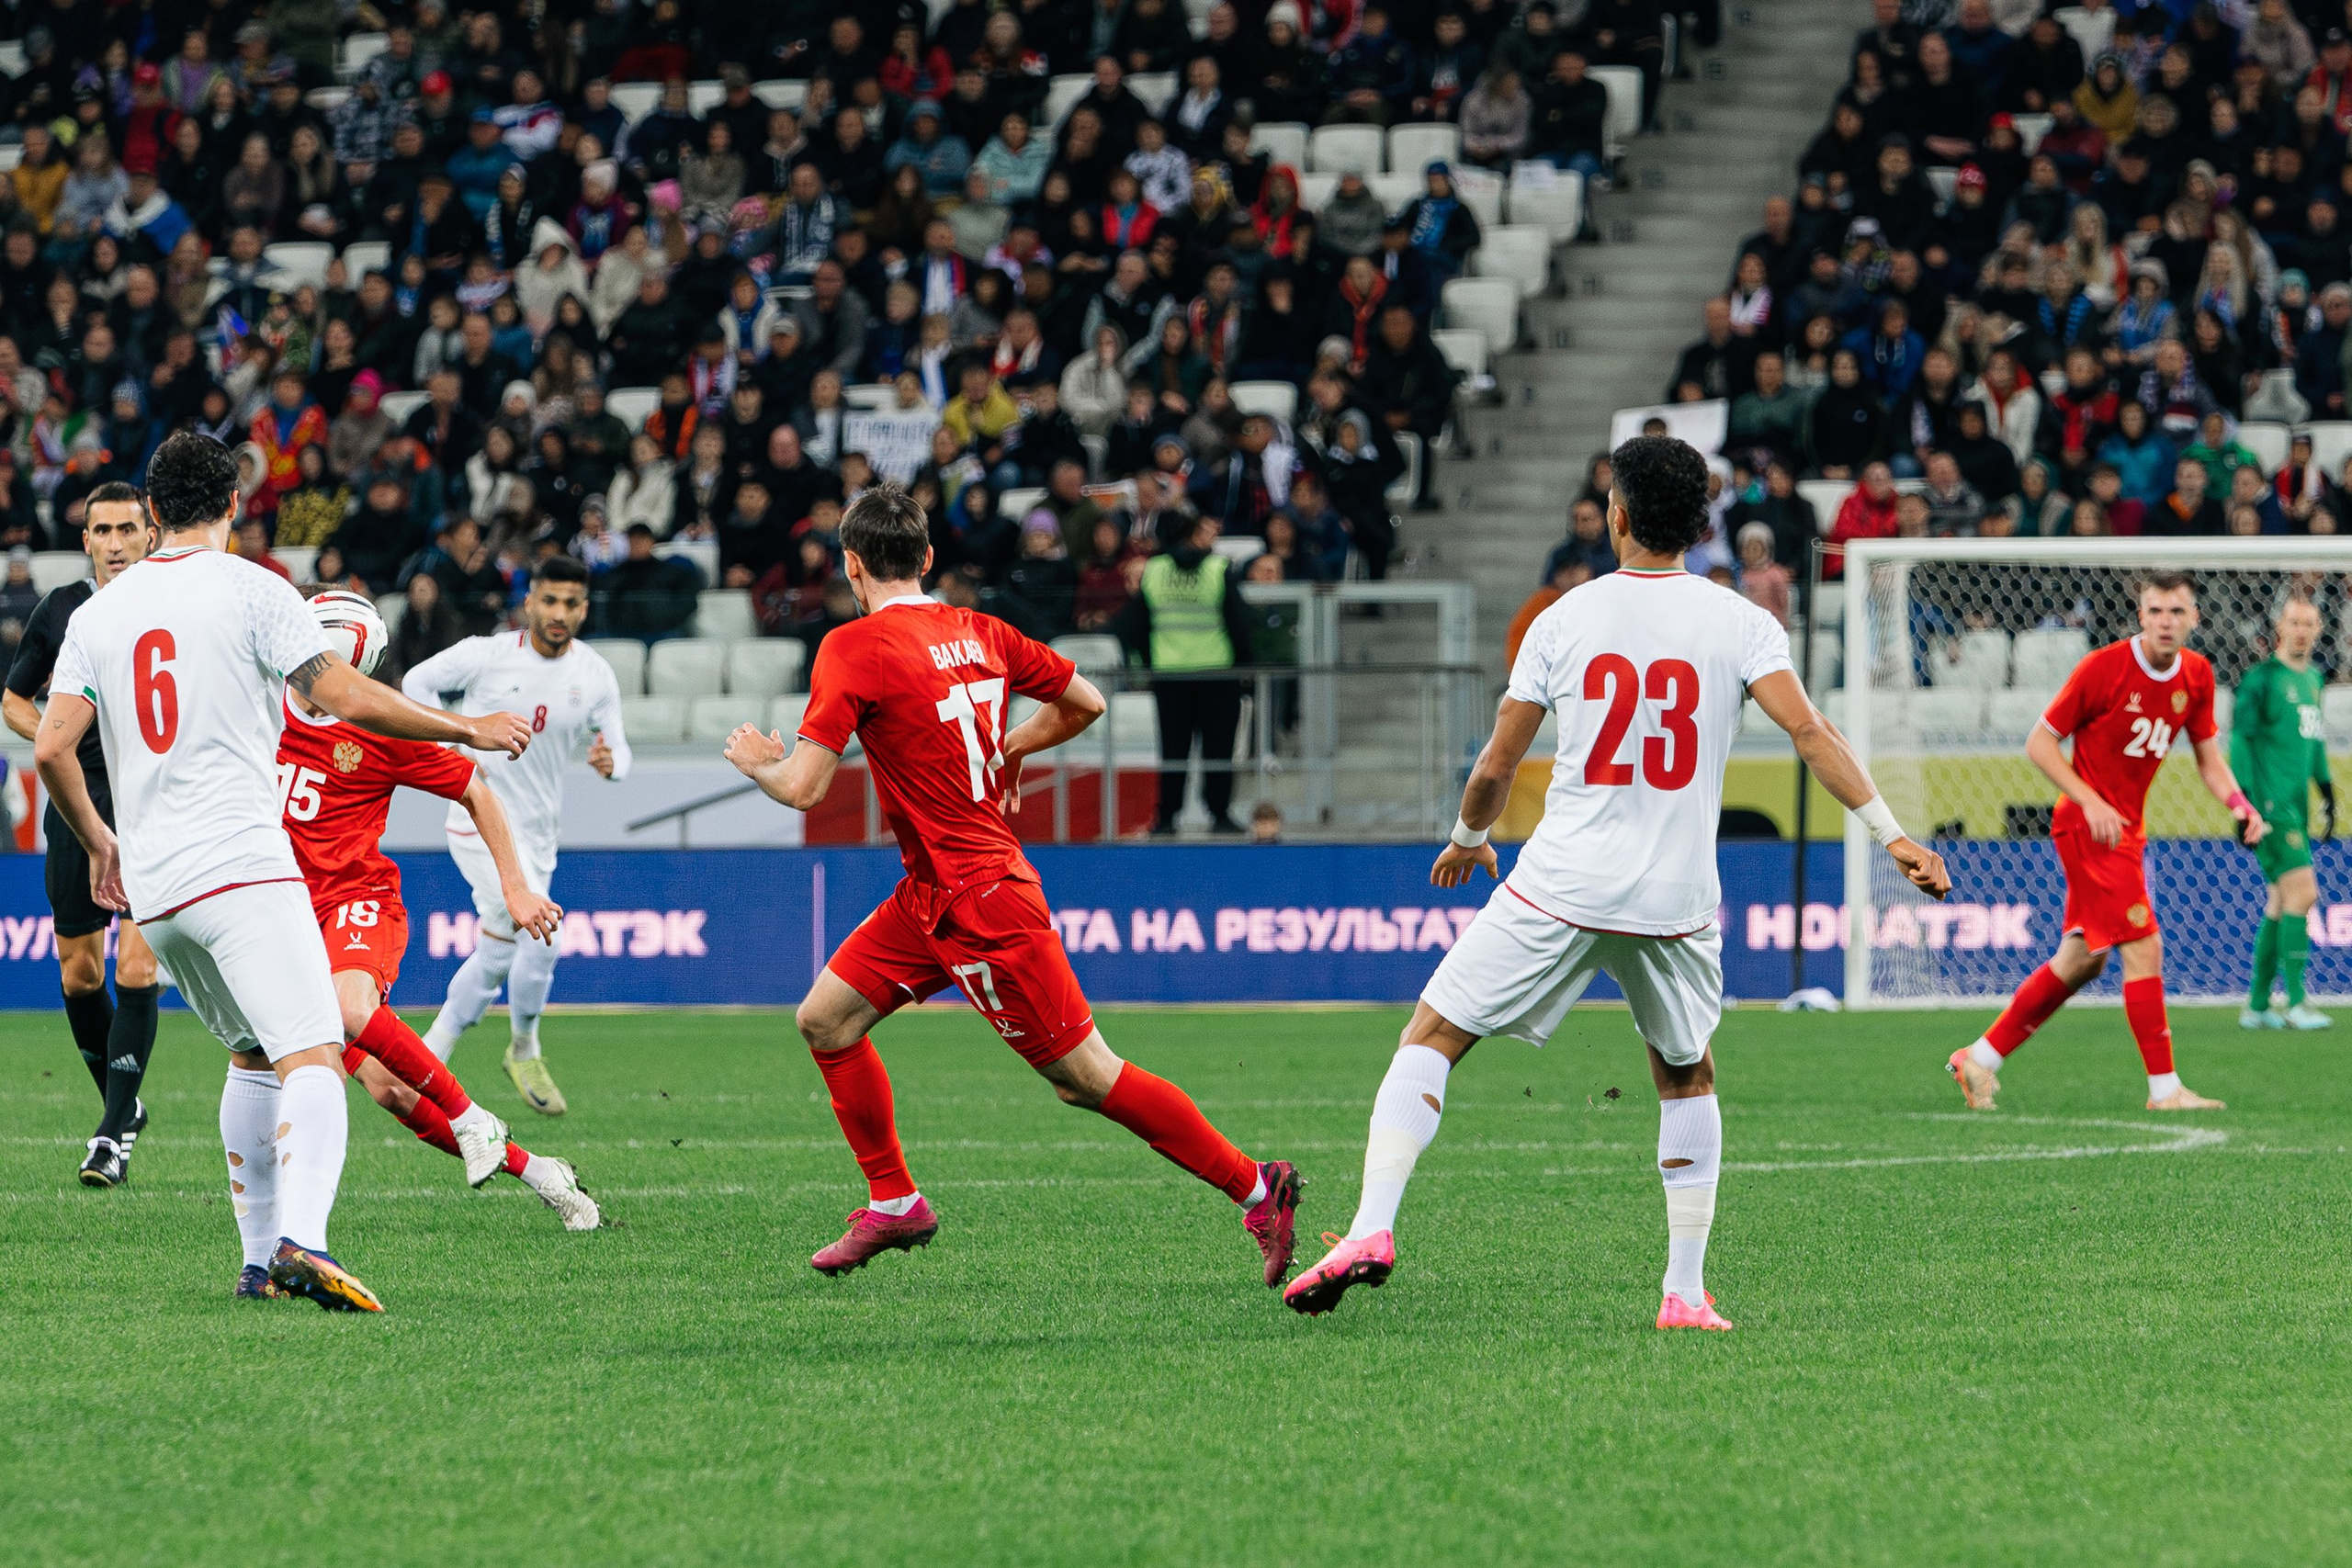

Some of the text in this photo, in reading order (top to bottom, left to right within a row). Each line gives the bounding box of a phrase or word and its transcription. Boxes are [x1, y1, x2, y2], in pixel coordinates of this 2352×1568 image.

[133, 628, 179, 754] 6
[533, 705, 548, 733] 8
[935, 676, 1005, 803] 17
[1583, 652, 1700, 791] 23
[2122, 716, 2172, 760] 24
[277, 761, 327, 821] 15
[428, 909, 707, 957] НАТЭК
[1131, 908, 1206, 953] НА
[951, 961, 1003, 1011] 17
